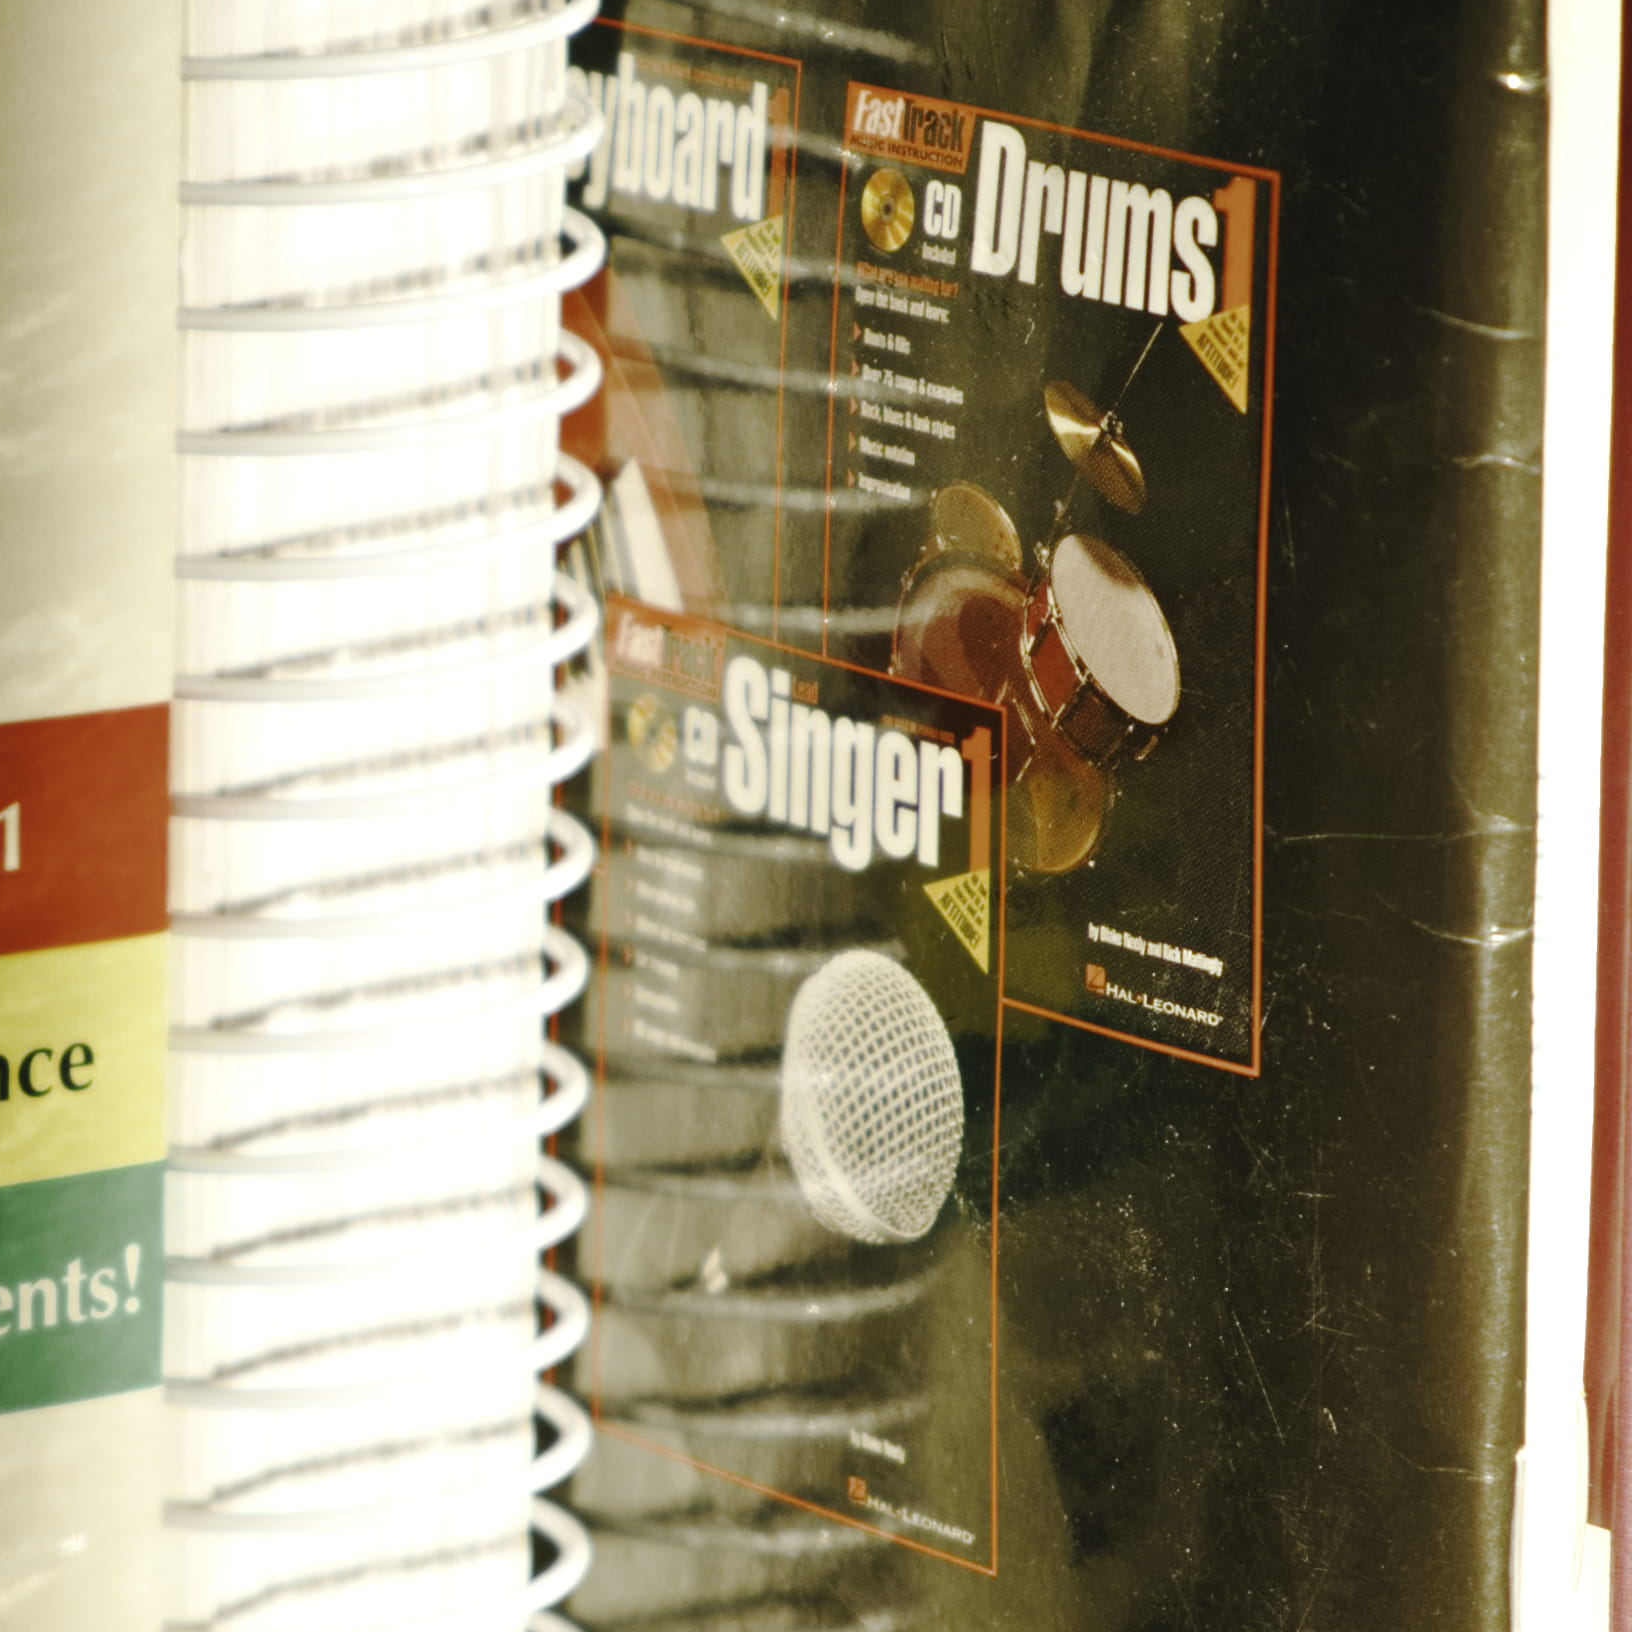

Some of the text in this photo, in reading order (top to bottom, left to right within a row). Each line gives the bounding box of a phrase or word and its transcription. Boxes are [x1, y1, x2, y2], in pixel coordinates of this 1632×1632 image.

[850, 135, 965, 169] MUSIC INSTRUCTION
[853, 89, 965, 153] FastTrack
[922, 179, 962, 240] CD
[970, 120, 1219, 325] Drums
[722, 656, 965, 872] Singer
